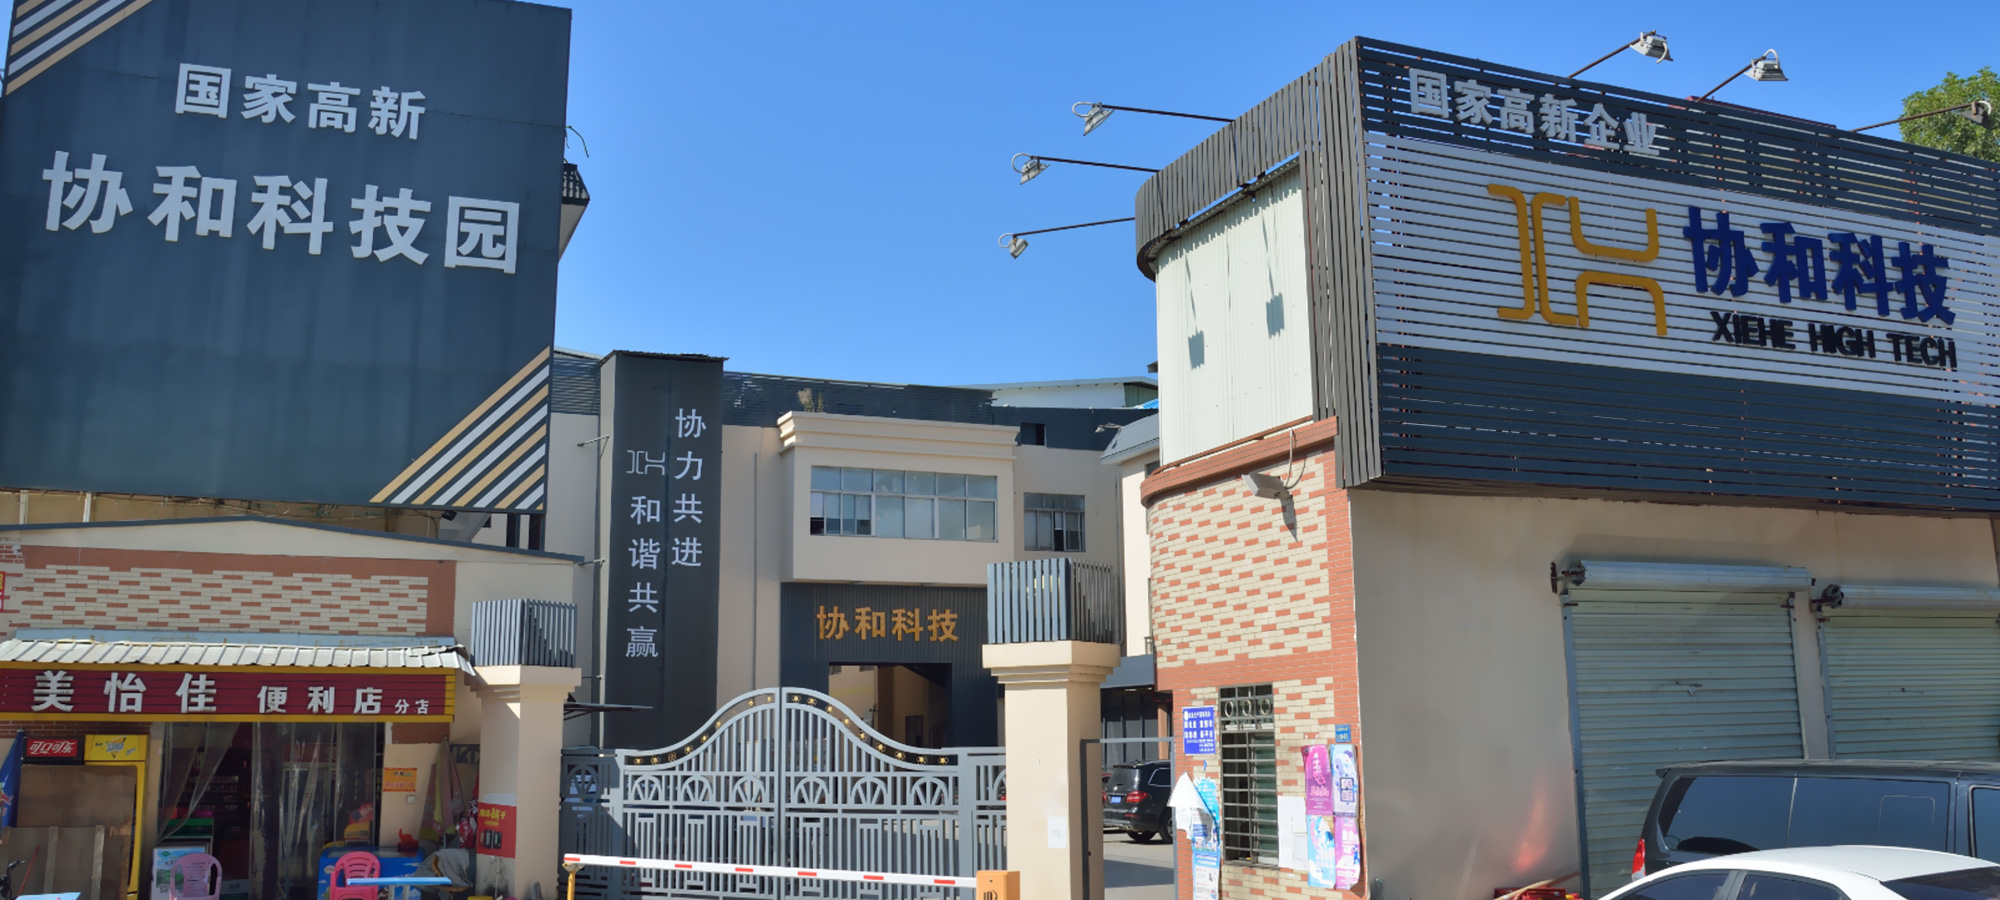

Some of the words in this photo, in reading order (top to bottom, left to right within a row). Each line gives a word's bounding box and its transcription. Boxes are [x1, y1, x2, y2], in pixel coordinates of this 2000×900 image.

[174, 62, 427, 140] 国家高新
[1408, 67, 1660, 157] 国家高新企业
[42, 150, 521, 274] 协和科技园
[1682, 205, 1956, 326] 协和科技
[1710, 311, 1795, 350] XIEHE
[1808, 322, 1876, 358] HIGH
[1886, 332, 1958, 368] TECH
[671, 407, 707, 568] 协力共进
[626, 495, 661, 658] 和谐共赢
[815, 604, 960, 643] 协和科技
[32, 670, 217, 713] 美怡佳
[256, 683, 384, 715] 便利店
[29, 740, 77, 755] 可口可乐
